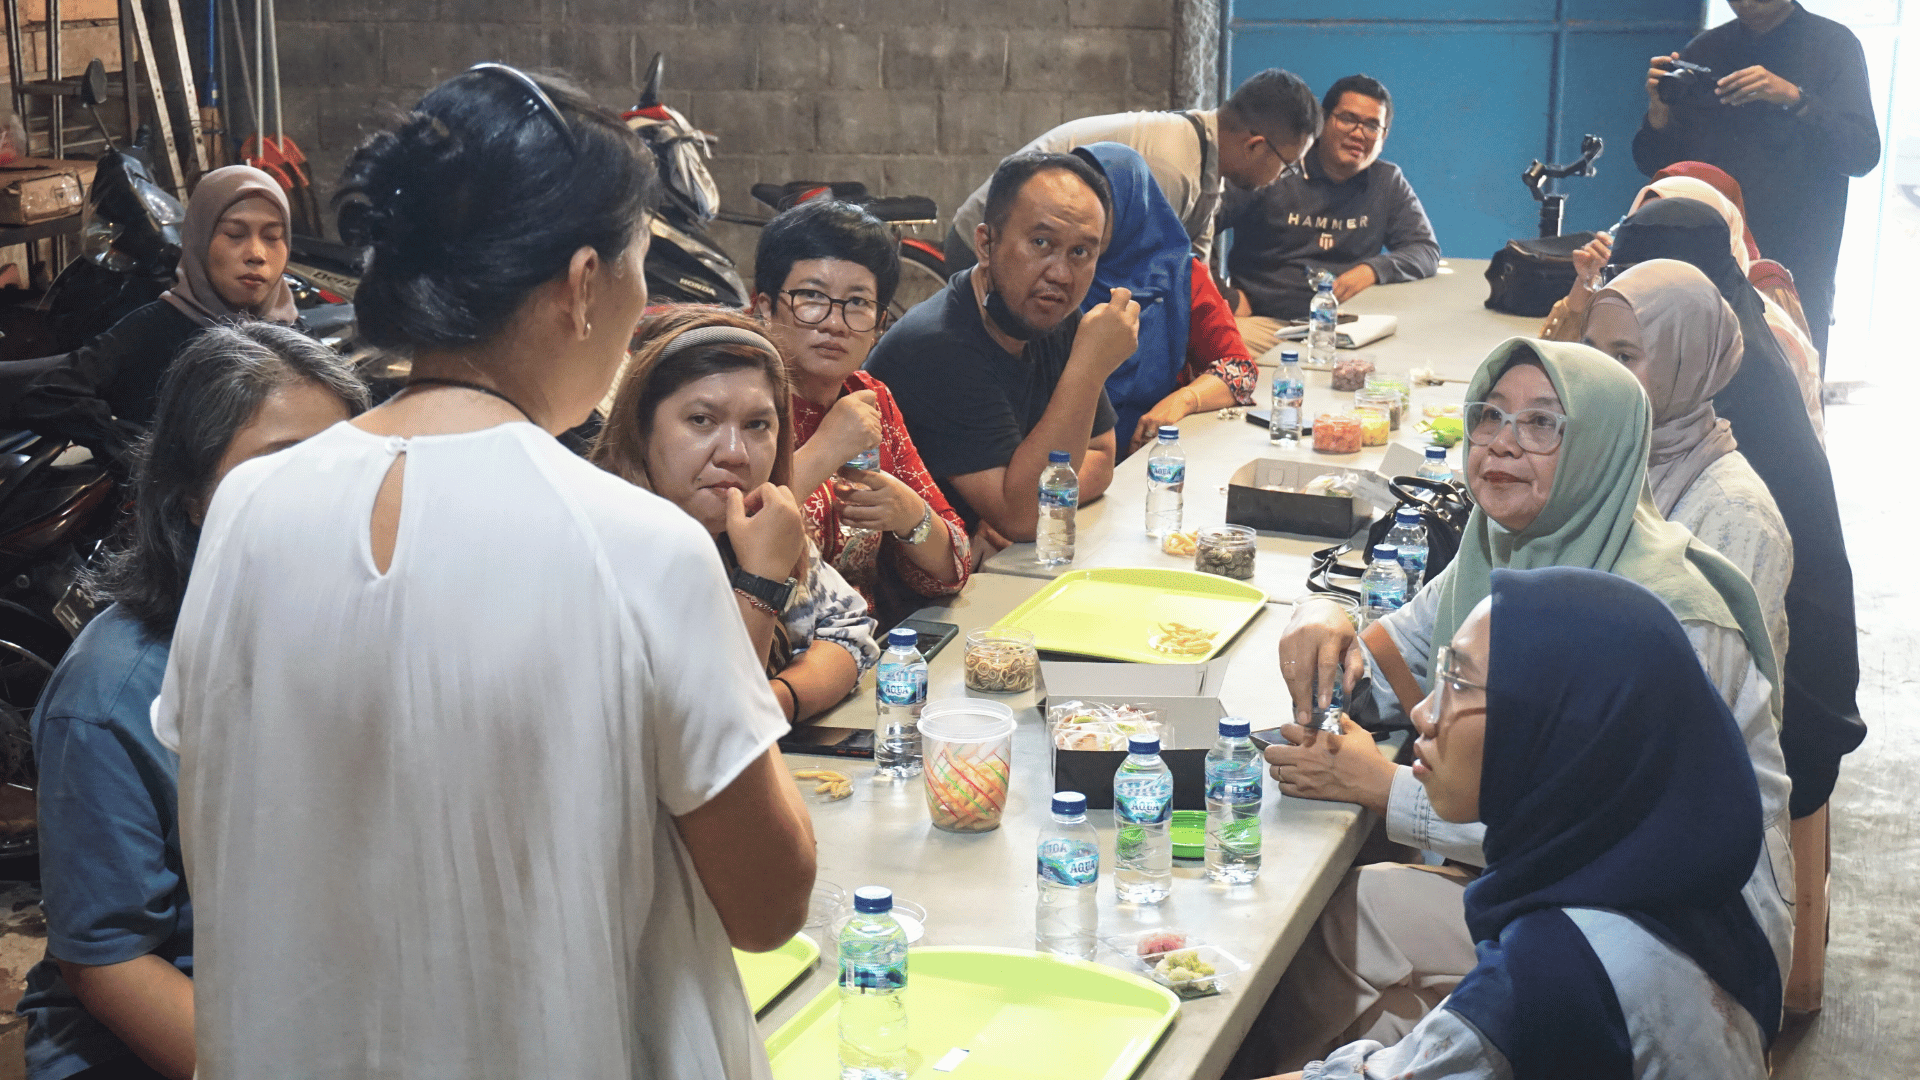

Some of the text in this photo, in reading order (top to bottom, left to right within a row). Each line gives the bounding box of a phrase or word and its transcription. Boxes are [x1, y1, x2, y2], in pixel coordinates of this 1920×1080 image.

[1288, 212, 1369, 231] HAMMER
[679, 277, 717, 296] HONDA
[76, 588, 95, 609] 3
[885, 684, 909, 696] AQUA
[1069, 860, 1096, 873] AQUA
